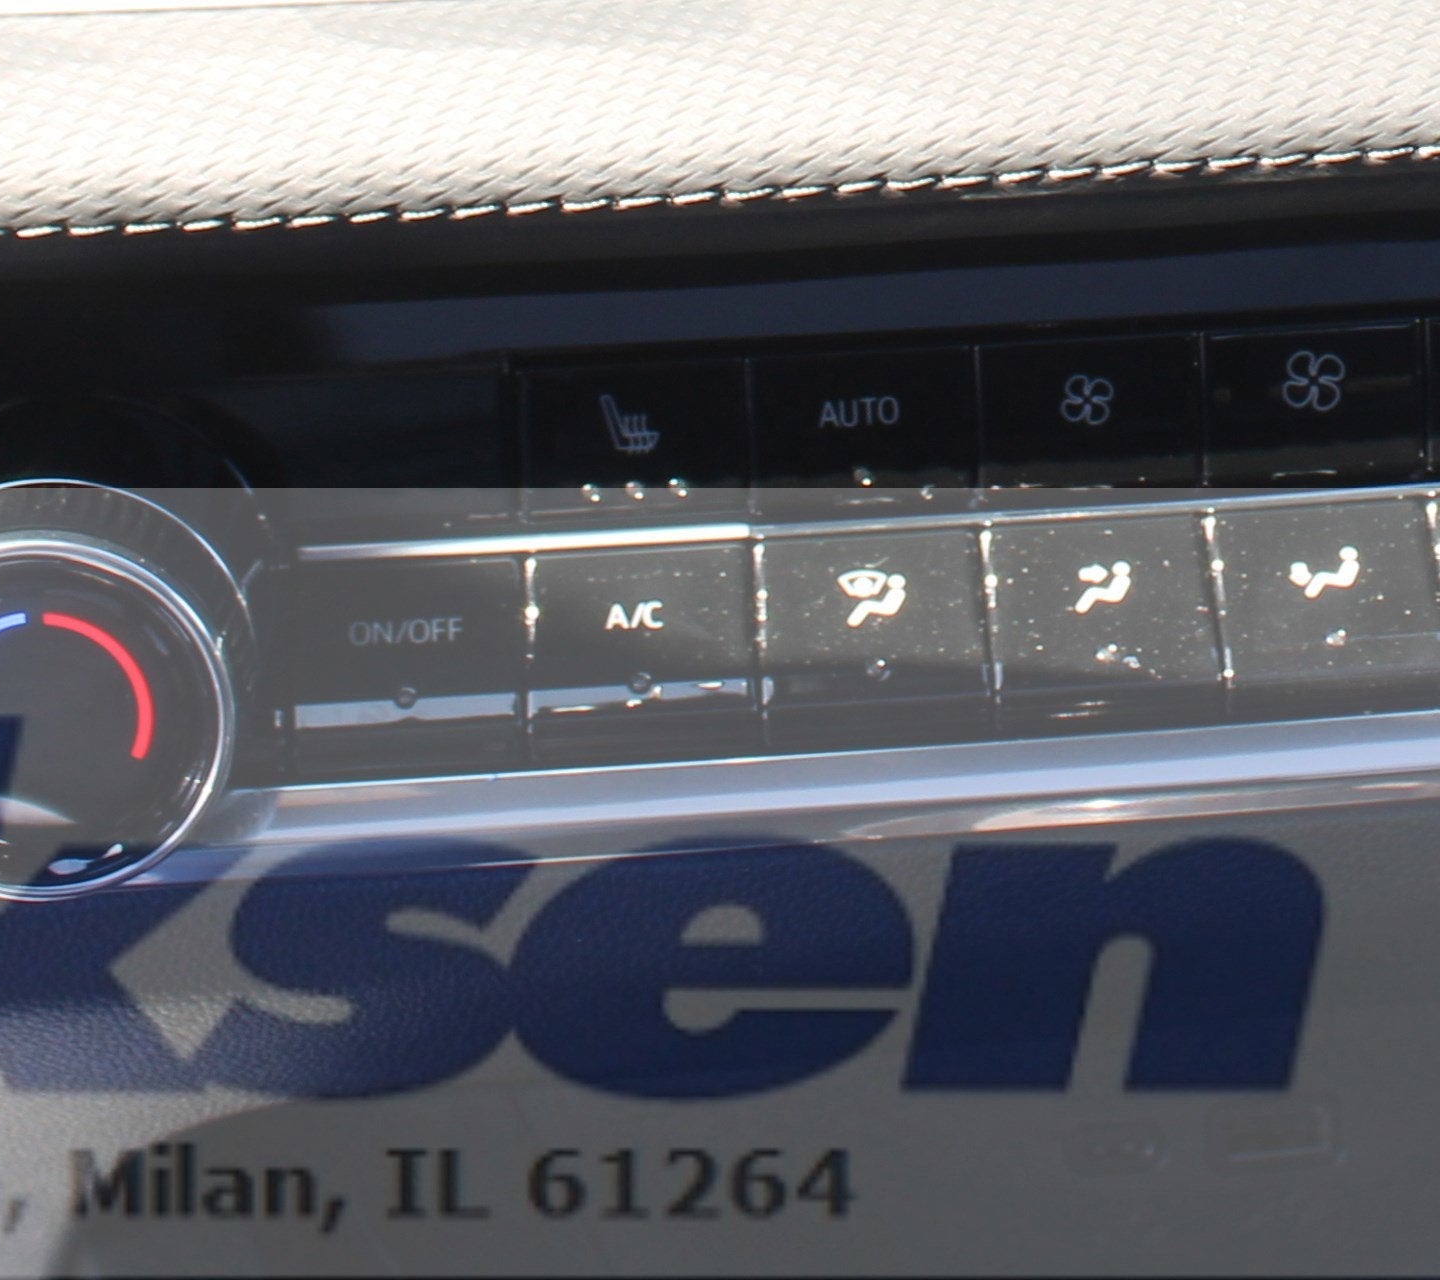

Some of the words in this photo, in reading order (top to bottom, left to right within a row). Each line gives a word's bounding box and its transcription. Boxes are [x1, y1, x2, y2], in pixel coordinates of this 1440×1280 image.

[818, 394, 901, 430] AUTO
[348, 614, 463, 647] ON/OFF
[605, 599, 665, 631] A/C
